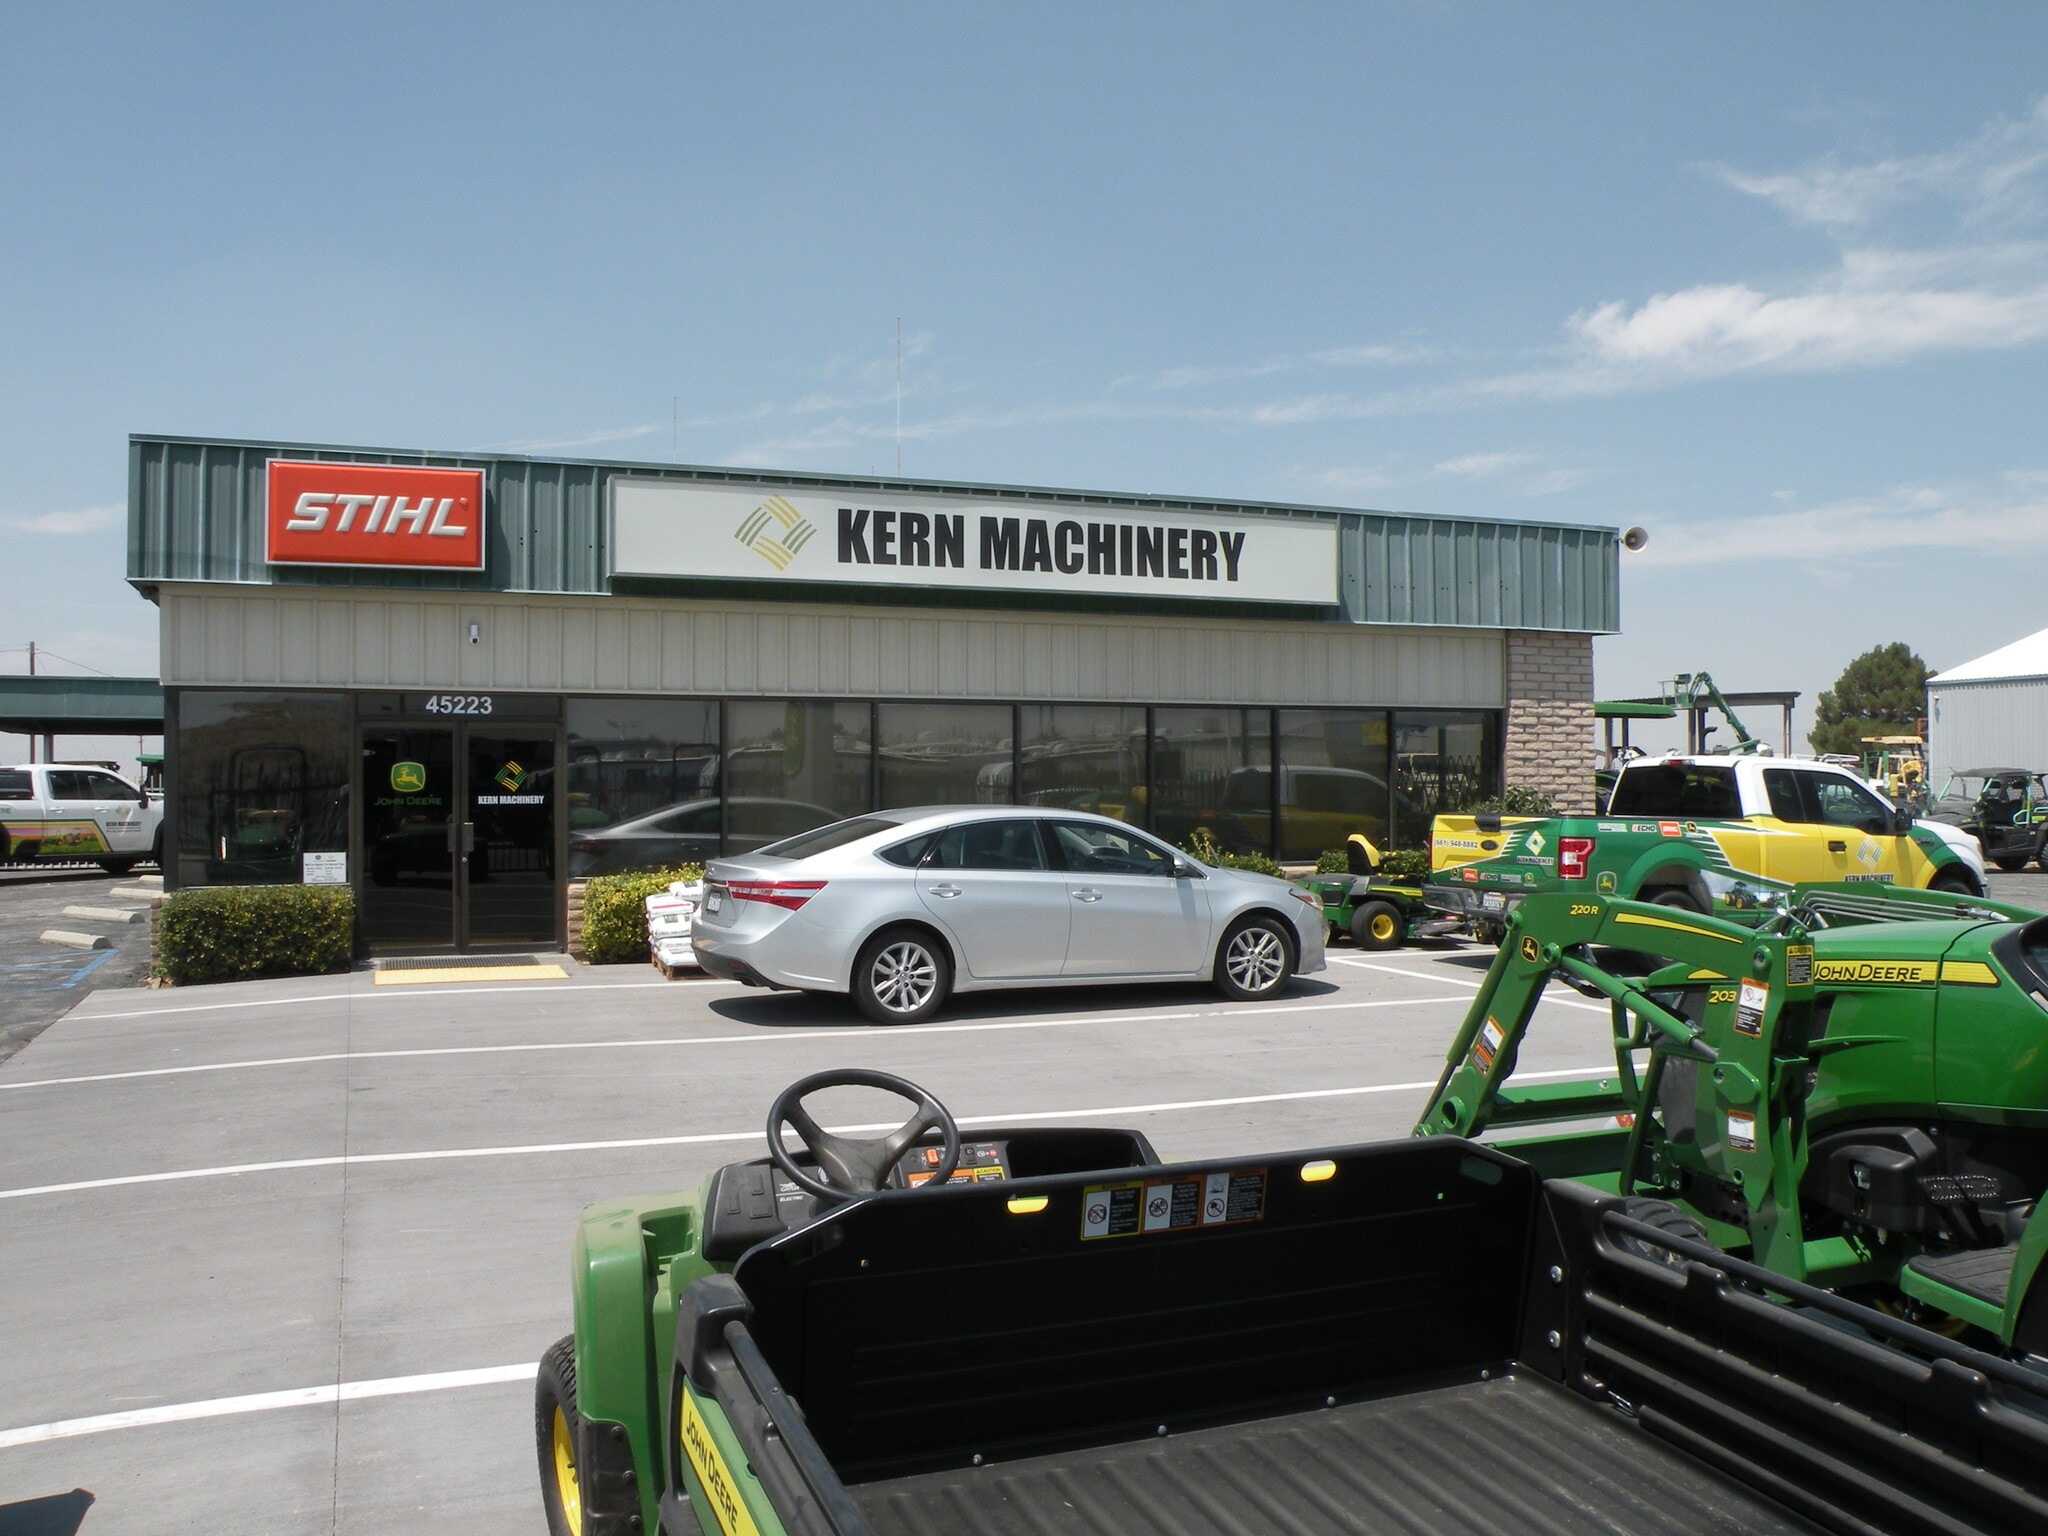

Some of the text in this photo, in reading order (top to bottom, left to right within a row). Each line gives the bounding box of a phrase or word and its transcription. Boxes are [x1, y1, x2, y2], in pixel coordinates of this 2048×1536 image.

[285, 492, 467, 536] STIHL
[837, 508, 1246, 582] KERN MACHINERY
[425, 695, 493, 714] 45223
[374, 796, 443, 806] JOHN DEERE
[478, 795, 545, 805] KERN MACHINERY
[1637, 824, 1656, 832] ECHO
[1433, 840, 1479, 849] (661) 948-8882
[1845, 873, 1895, 882] KERN MACHINERY
[1814, 965, 1856, 980] JOHN
[1857, 964, 1923, 980] DEERE
[686, 1411, 738, 1532] JOHN DEERE
